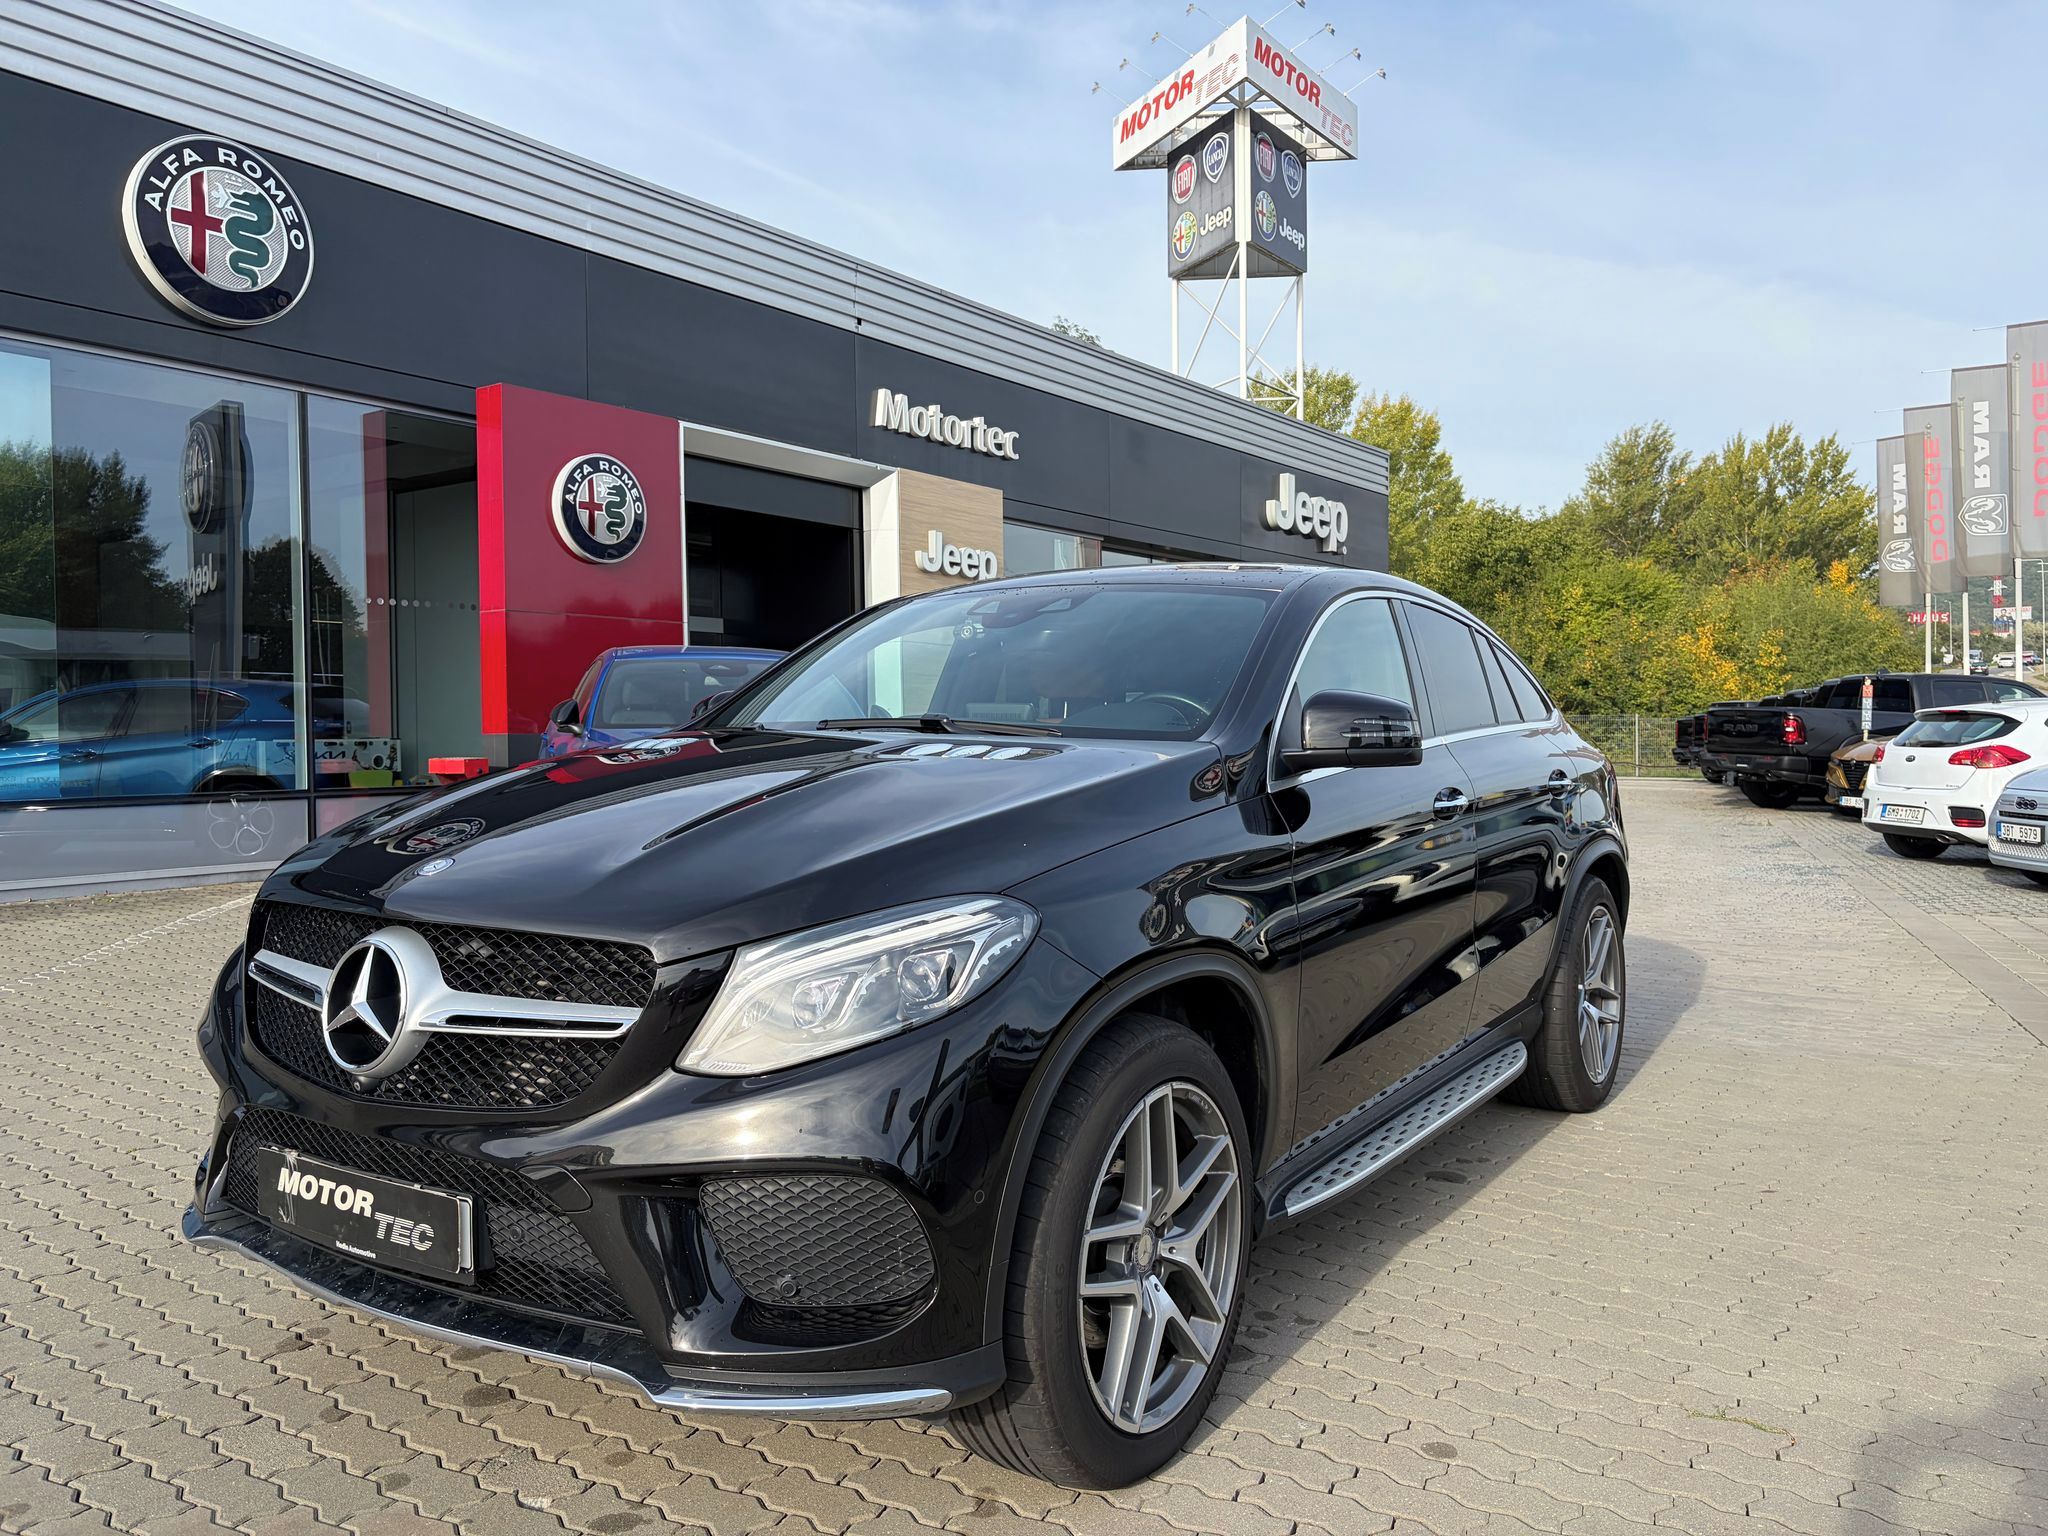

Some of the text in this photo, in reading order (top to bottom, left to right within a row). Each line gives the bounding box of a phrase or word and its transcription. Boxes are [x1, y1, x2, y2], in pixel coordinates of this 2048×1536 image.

[1120, 53, 1240, 144] MOTOR TEC
[1254, 36, 1353, 147] MOTOR TEC
[1177, 166, 1192, 193] FIAT
[1259, 143, 1272, 171] FIAT
[144, 147, 305, 250] ALFA ROMEO
[1200, 206, 1232, 236] Jeep
[1279, 217, 1305, 251] Jeep
[874, 388, 1020, 460] Motortec
[565, 460, 643, 514] ALFA ROMEO
[1265, 473, 1348, 552] Jeep
[914, 530, 998, 580] Jeep
[1908, 612, 1949, 622] HAUS
[1723, 723, 1758, 732] RAM
[1904, 809, 1920, 819] 1702
[277, 1167, 435, 1251] MOTOR TEC
